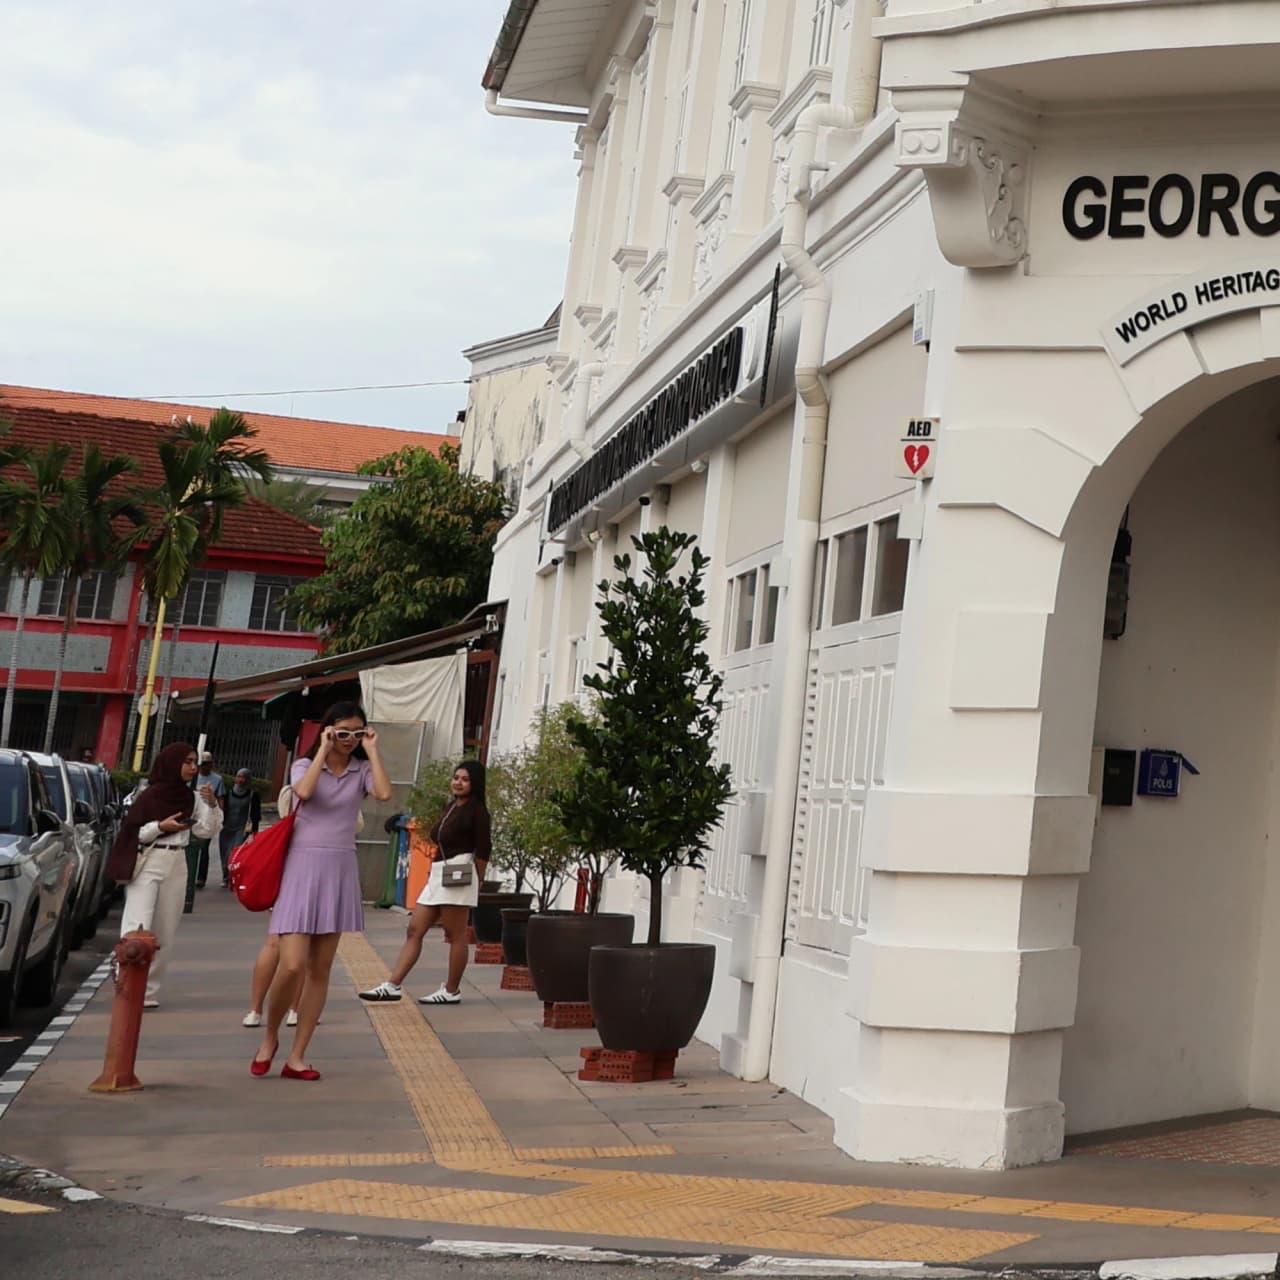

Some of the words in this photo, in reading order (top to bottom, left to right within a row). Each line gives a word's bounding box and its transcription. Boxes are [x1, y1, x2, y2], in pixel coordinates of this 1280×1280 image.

[1115, 291, 1188, 344] WORLD
[907, 421, 931, 437] AED
[1152, 777, 1173, 789] POLIS
